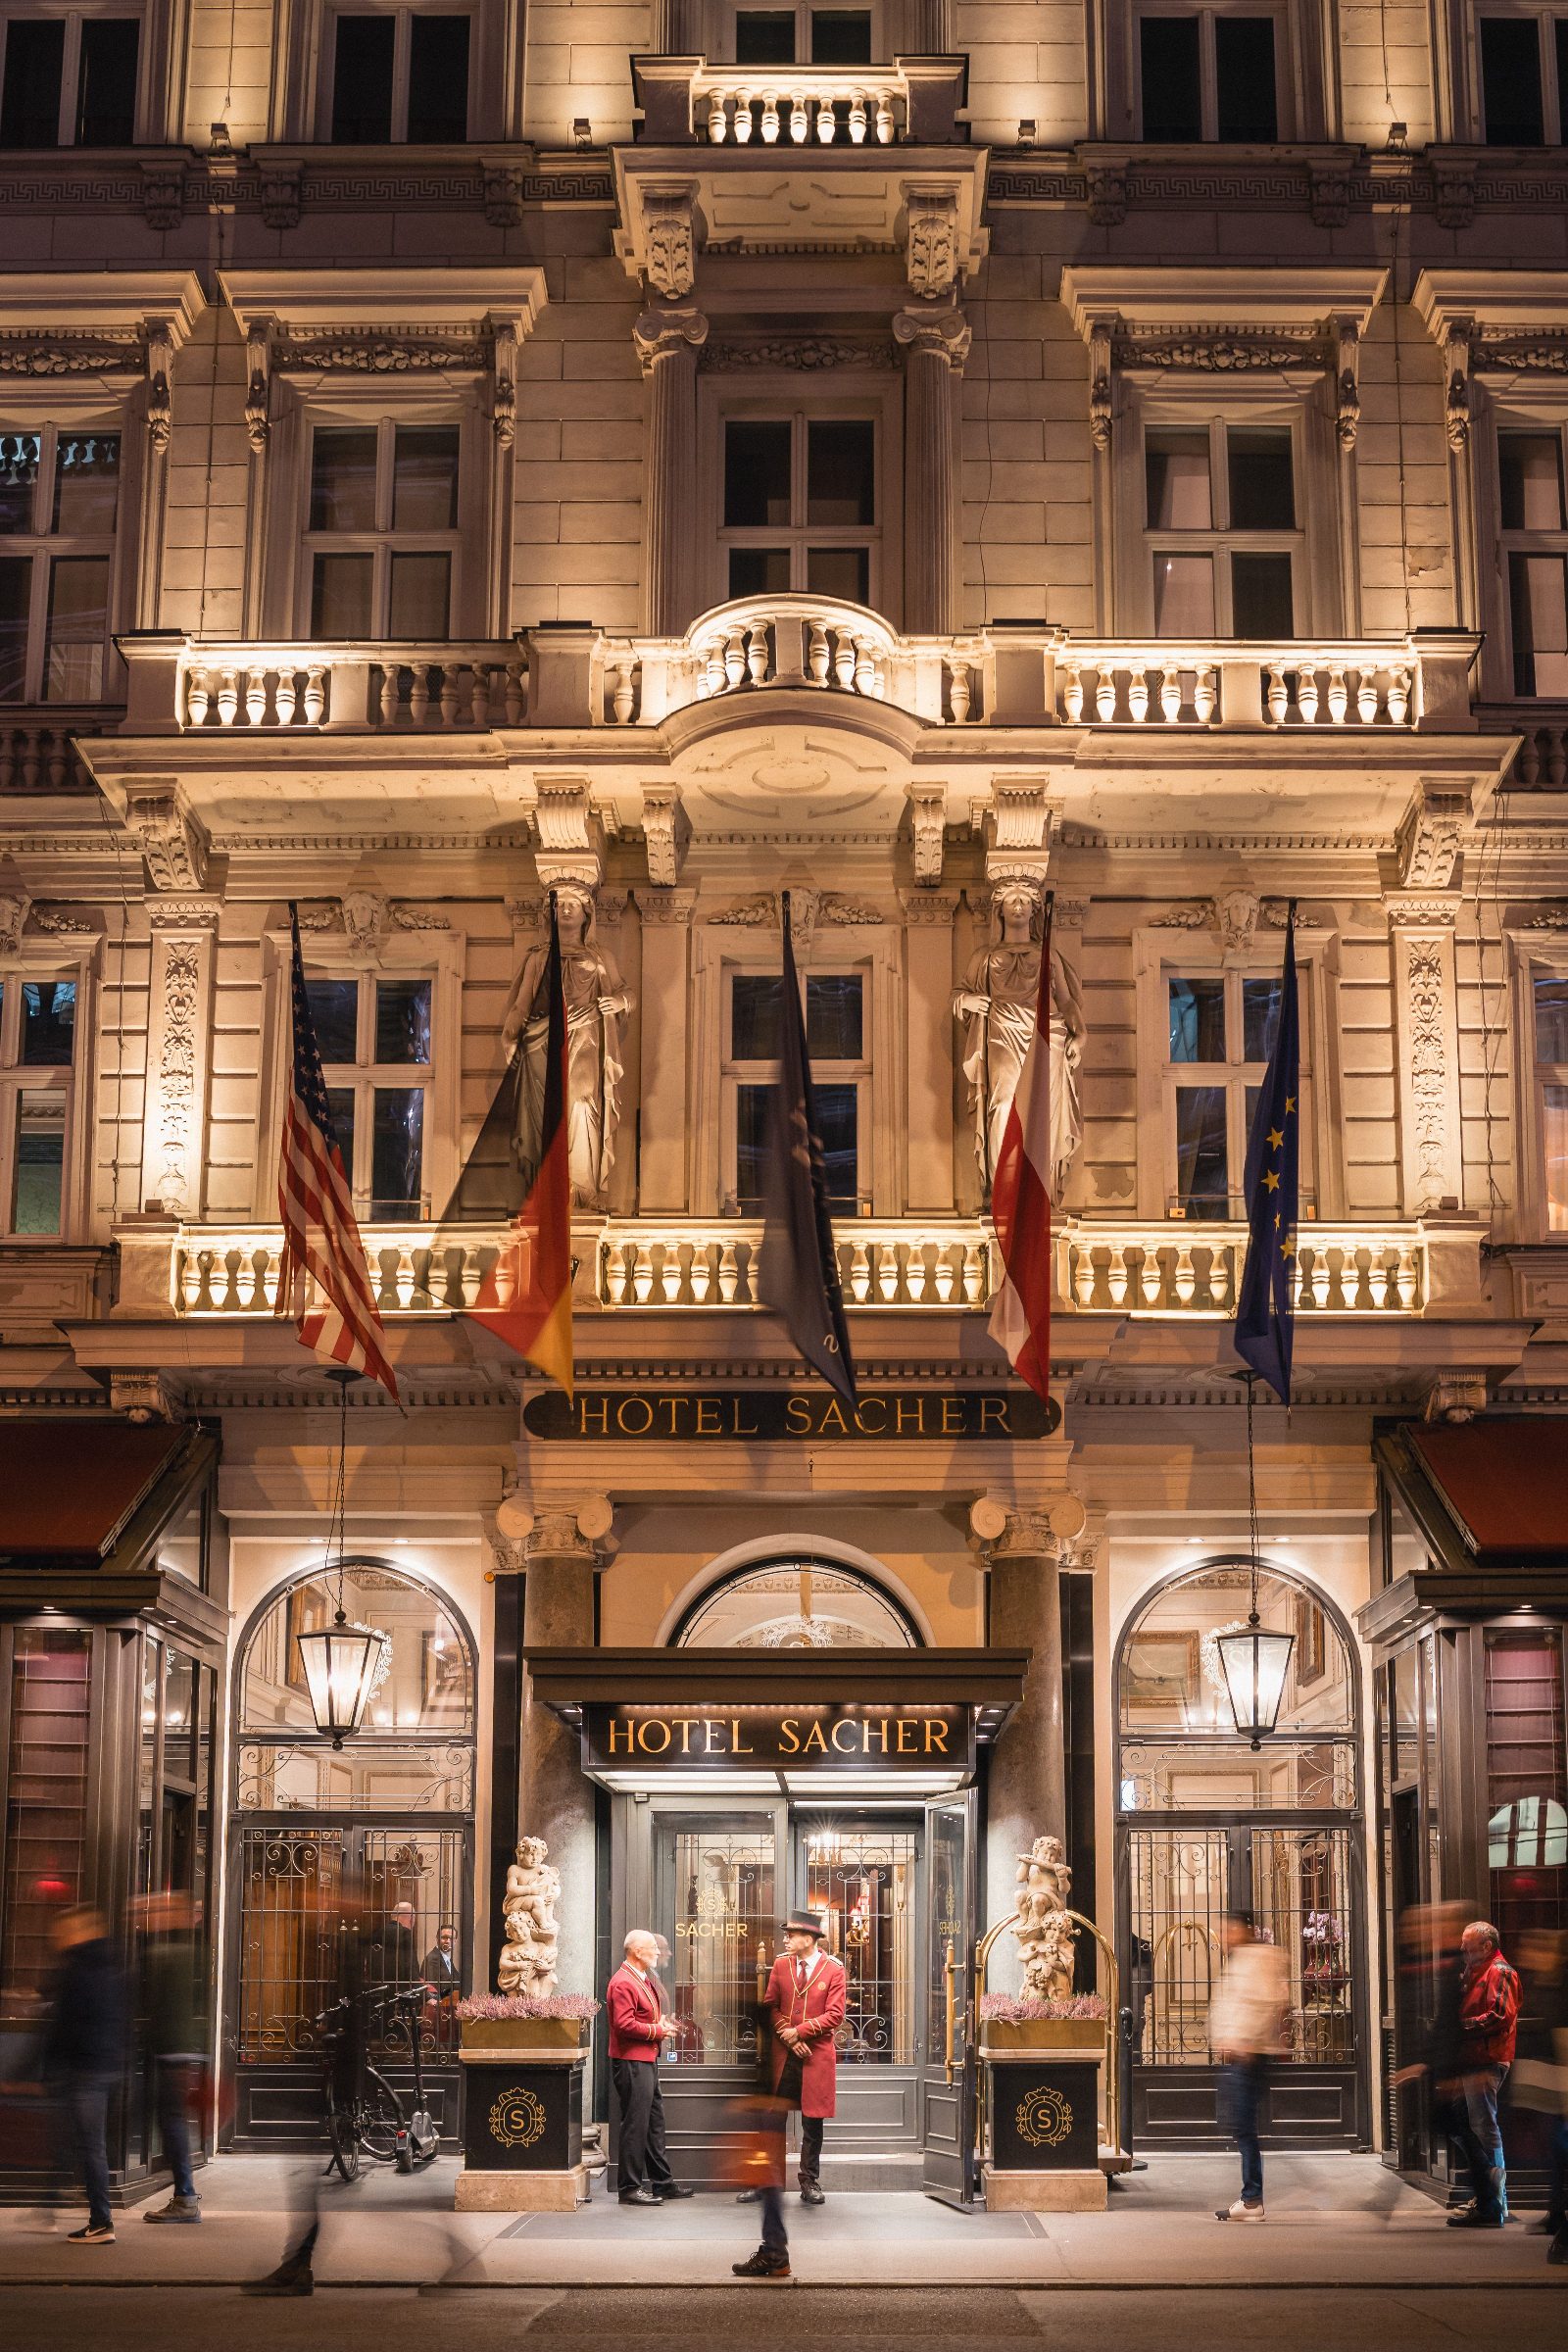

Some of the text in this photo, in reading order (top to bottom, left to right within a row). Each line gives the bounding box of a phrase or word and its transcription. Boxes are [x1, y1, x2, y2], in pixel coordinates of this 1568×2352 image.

[785, 1397, 1012, 1434] SACHER
[608, 1718, 949, 1753] HOTEL SACHER
[707, 1899, 715, 1910] S
[675, 1923, 748, 1937] SACHER
[511, 2110, 524, 2130] S
[1037, 2109, 1052, 2130] S
